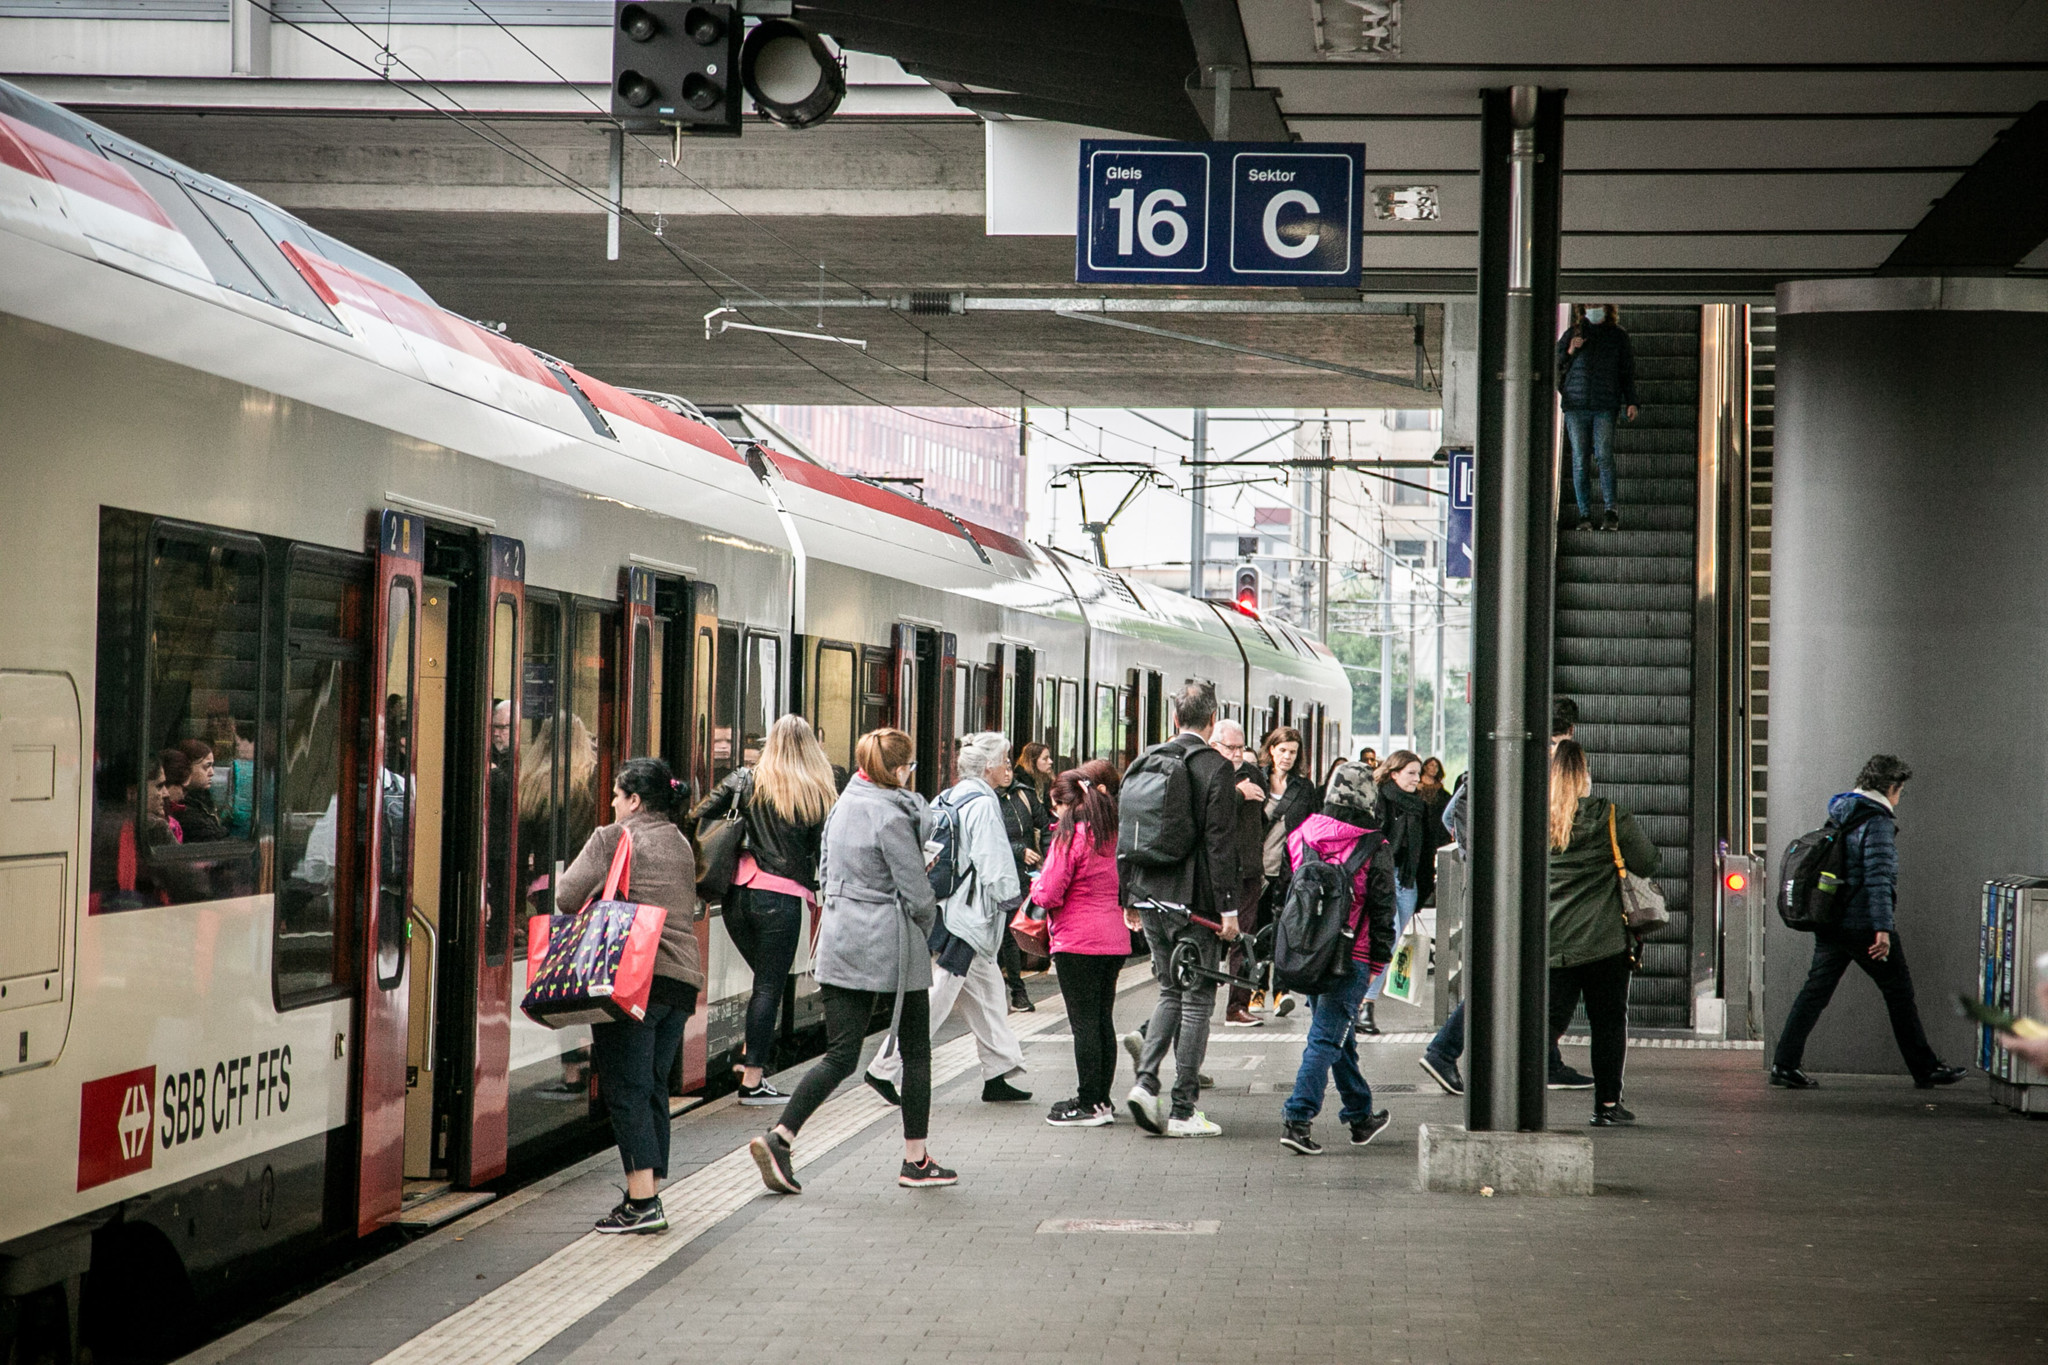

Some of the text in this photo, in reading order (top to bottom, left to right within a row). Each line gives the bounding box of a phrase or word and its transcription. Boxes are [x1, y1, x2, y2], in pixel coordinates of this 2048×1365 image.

[1106, 166, 1142, 180] Gleis
[1248, 168, 1296, 182] Sektor
[1109, 188, 1189, 257] 16
[1262, 189, 1320, 258] C
[390, 515, 397, 552] 2
[514, 545, 520, 577] 2
[161, 1044, 292, 1150] SBB CFF FFS
